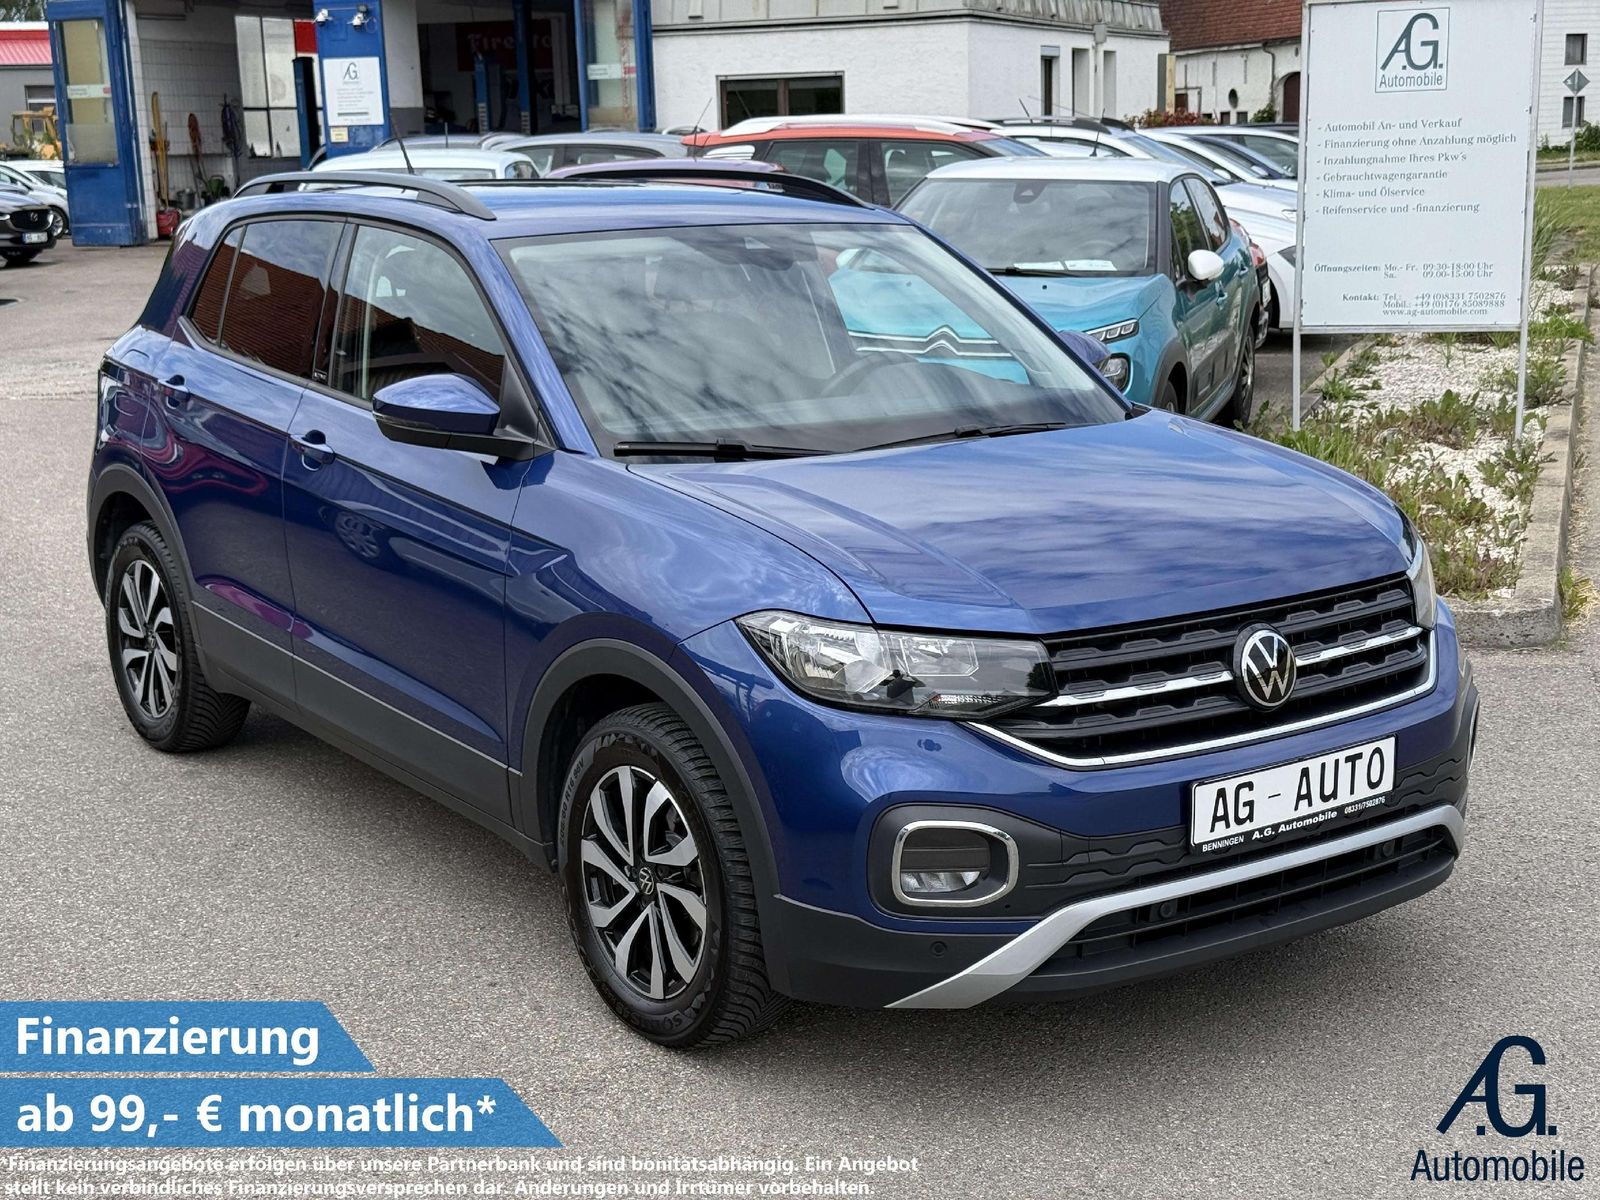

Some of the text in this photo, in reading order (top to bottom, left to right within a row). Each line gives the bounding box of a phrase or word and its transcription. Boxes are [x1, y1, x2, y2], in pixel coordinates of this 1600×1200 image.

[467, 32, 552, 50] Fireto
[1379, 72, 1443, 89] Automobile
[1324, 118, 1462, 132] Automobil An- und Verkauf
[1324, 133, 1517, 149] Finanzierung ohne Anzahlung möglich
[1323, 154, 1406, 166] Inzahlungnahme
[1409, 153, 1435, 163] Ihres
[1323, 170, 1448, 182] Gebrauchtwagengarantie
[1323, 186, 1425, 198] Klima- und Ölservice
[1322, 202, 1480, 215] Reifenservice und -finanzierung
[1314, 263, 1381, 273] Öffnungszeiten:
[1405, 263, 1418, 271] Fr.
[1477, 262, 1494, 270] Uhr
[1384, 271, 1397, 279] Sa.
[1477, 270, 1494, 278] Uhr
[1342, 293, 1380, 302] Kontakt:
[1468, 291, 1506, 300] 7502876
[1382, 308, 1488, 317] www.ag-automobile.com
[1209, 780, 1254, 833] AG
[1293, 747, 1385, 811] AUTO
[1202, 835, 1245, 852] BENNINGEN
[1252, 828, 1276, 841] A.G.
[1278, 811, 1338, 833] Automobile
